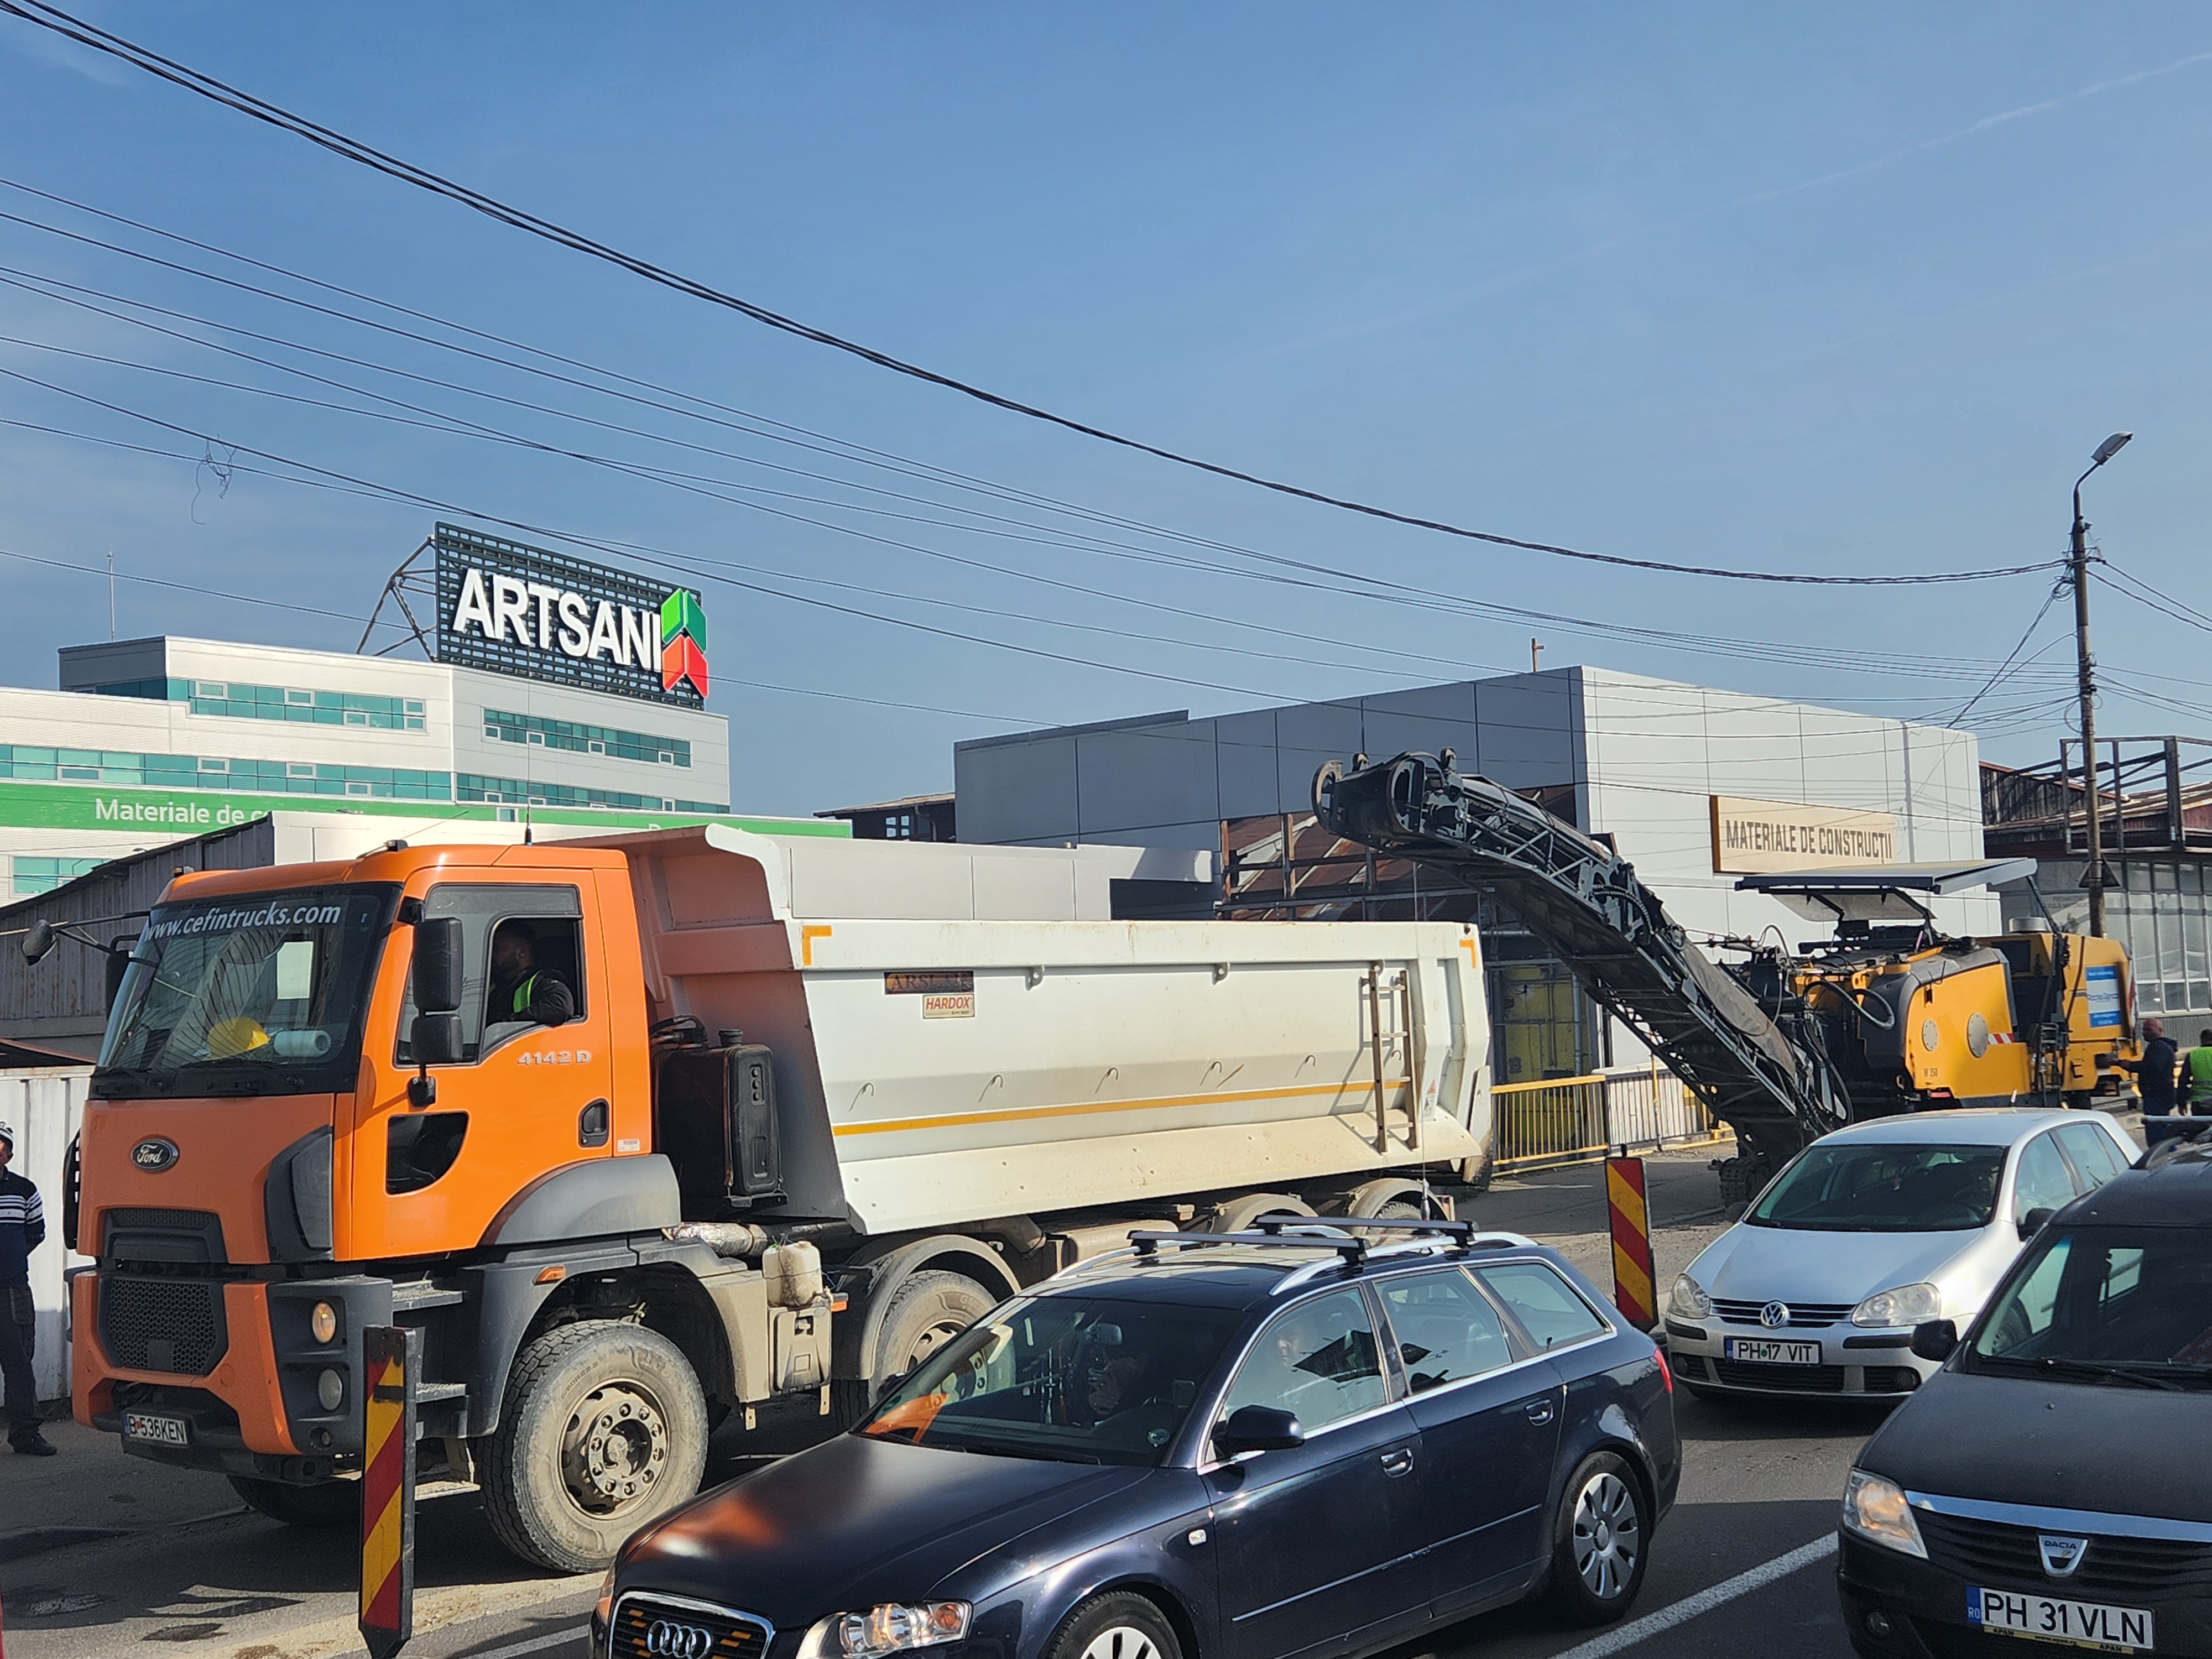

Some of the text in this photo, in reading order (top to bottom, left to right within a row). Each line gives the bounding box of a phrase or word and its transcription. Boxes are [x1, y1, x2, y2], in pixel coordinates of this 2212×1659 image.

[453, 568, 662, 672] ARTSANI
[95, 798, 209, 823] Materiale
[216, 804, 244, 825] de
[1726, 820, 1797, 853] MATERIALE
[1800, 826, 1816, 854] DE
[144, 901, 341, 942] www.cefintrucks.com
[926, 997, 971, 1010] HARDOX
[517, 1051, 591, 1065] 4142 D
[137, 1144, 164, 1163] Ford
[1738, 1342, 1760, 1359] PH
[1766, 1344, 1781, 1360] 17
[1787, 1345, 1812, 1362] VIT
[128, 1416, 137, 1434] B
[2044, 1540, 2077, 1550] DACIA
[1968, 1606, 1980, 1619] RO
[1984, 1592, 2145, 1645] PH 31 VLN
[2099, 1644, 2122, 1653] APAN
